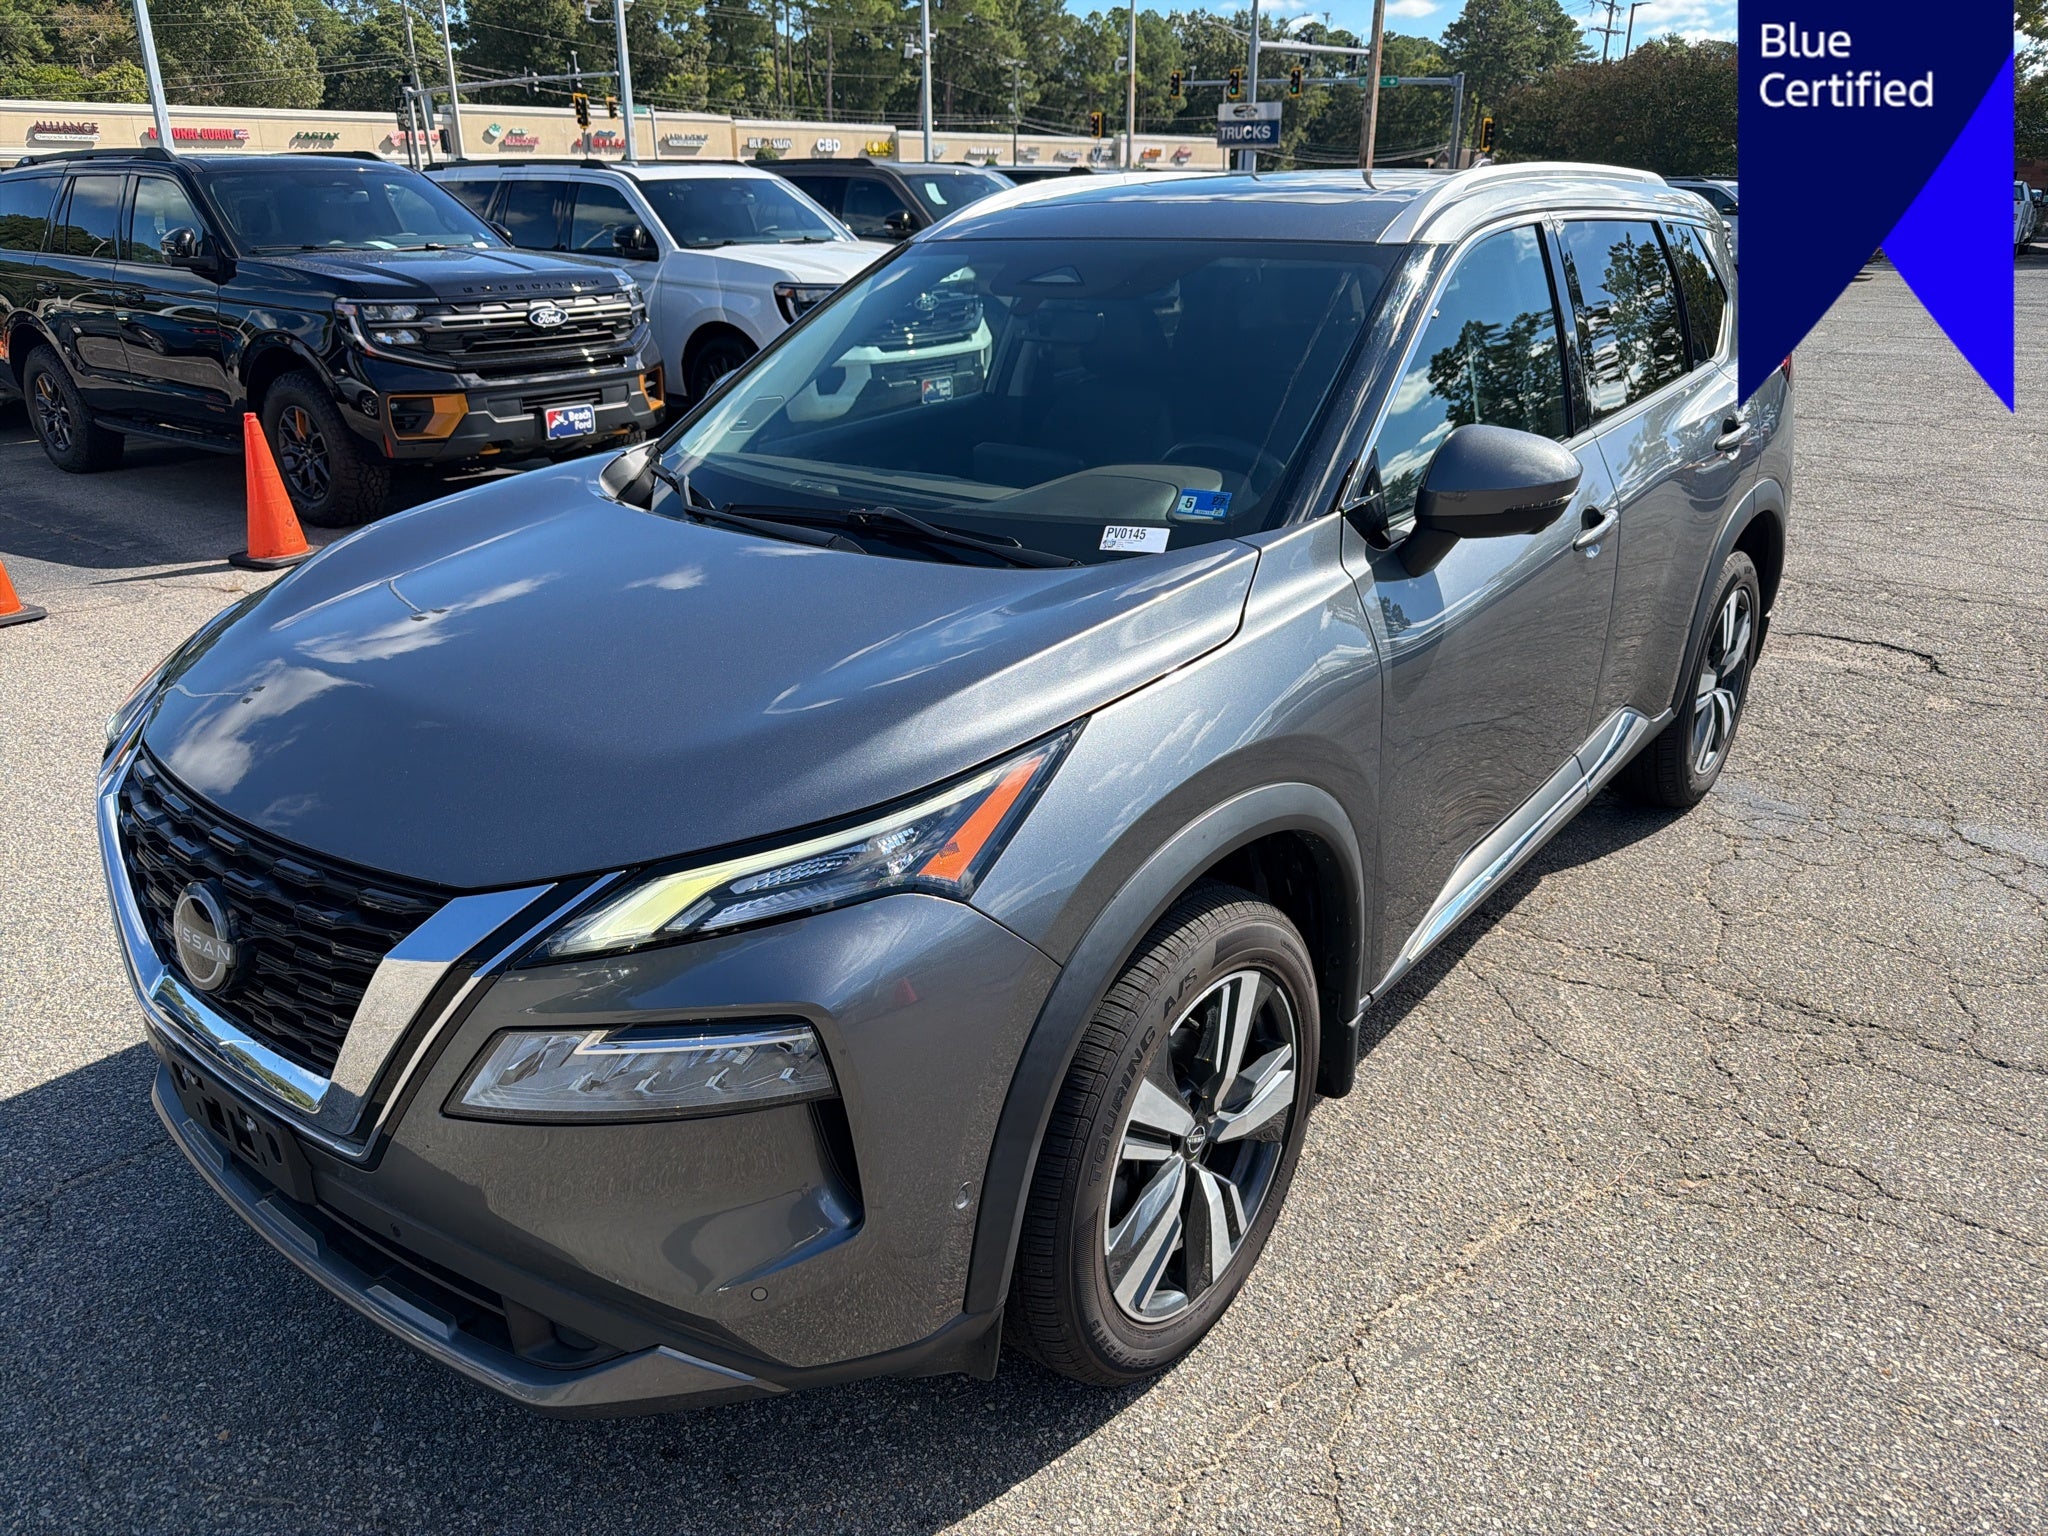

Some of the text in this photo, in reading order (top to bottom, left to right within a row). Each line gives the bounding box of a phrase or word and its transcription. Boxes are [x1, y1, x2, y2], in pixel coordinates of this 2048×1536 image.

[33, 119, 99, 135] ALLIANCE
[148, 127, 235, 140] NIONAL GUARD
[1220, 124, 1272, 140] TRUCKS
[816, 138, 841, 152] CBD
[537, 310, 562, 324] Ford
[568, 409, 592, 421] Beach
[574, 418, 592, 430] Ford
[1184, 497, 1195, 509] 5
[1106, 527, 1147, 540] PV0145
